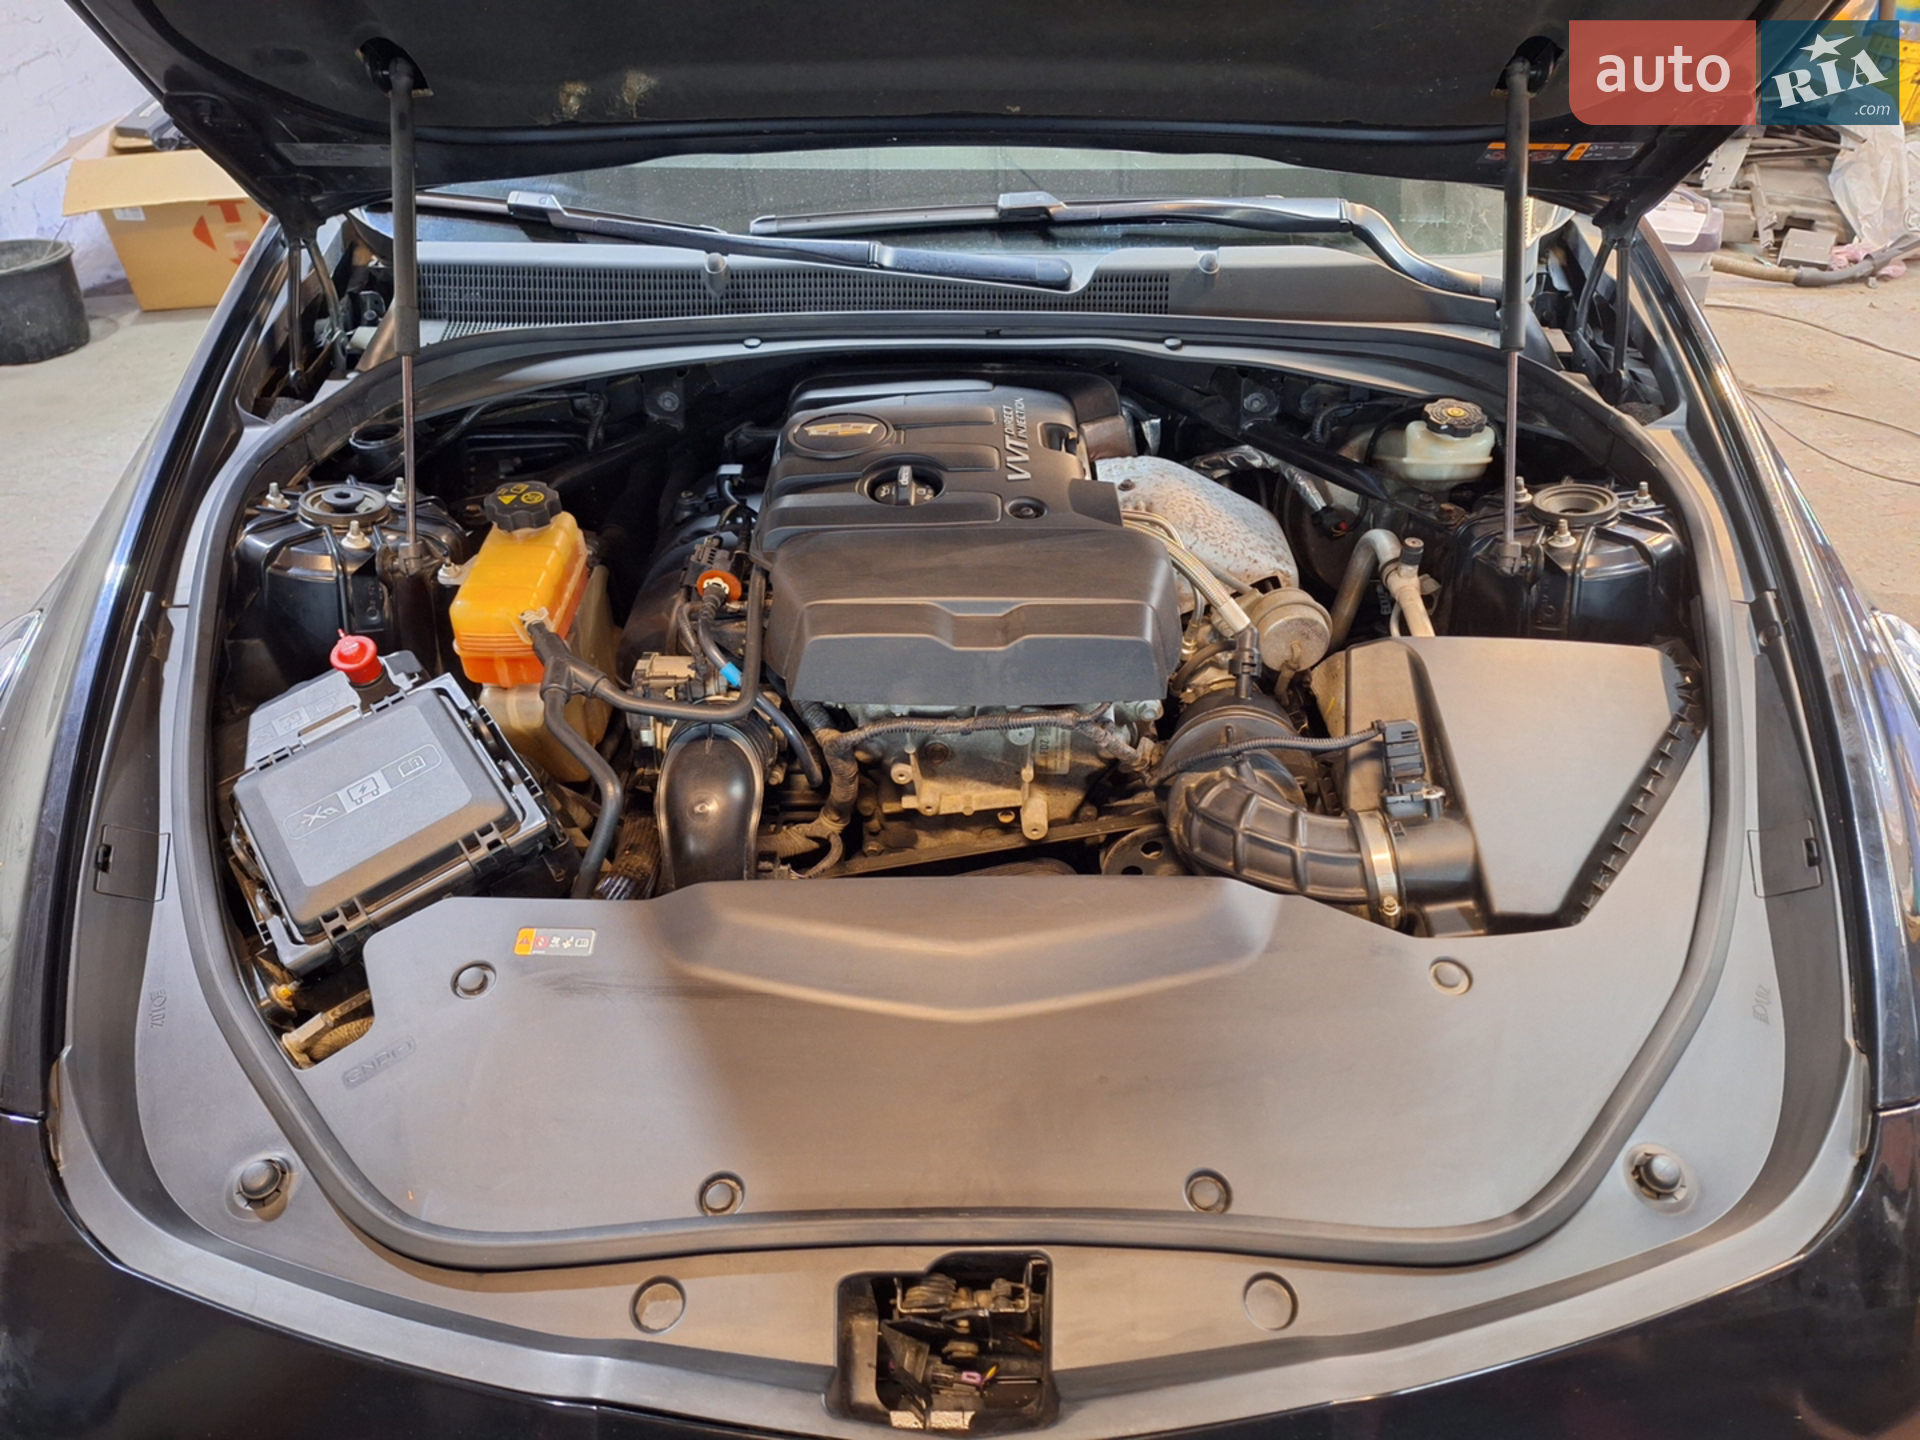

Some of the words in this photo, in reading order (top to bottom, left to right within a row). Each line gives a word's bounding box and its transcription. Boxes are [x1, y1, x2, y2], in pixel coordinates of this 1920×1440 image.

[1003, 404, 1015, 436] DIRECT
[1014, 396, 1027, 439] INJECTION
[1005, 434, 1031, 481] VVT
